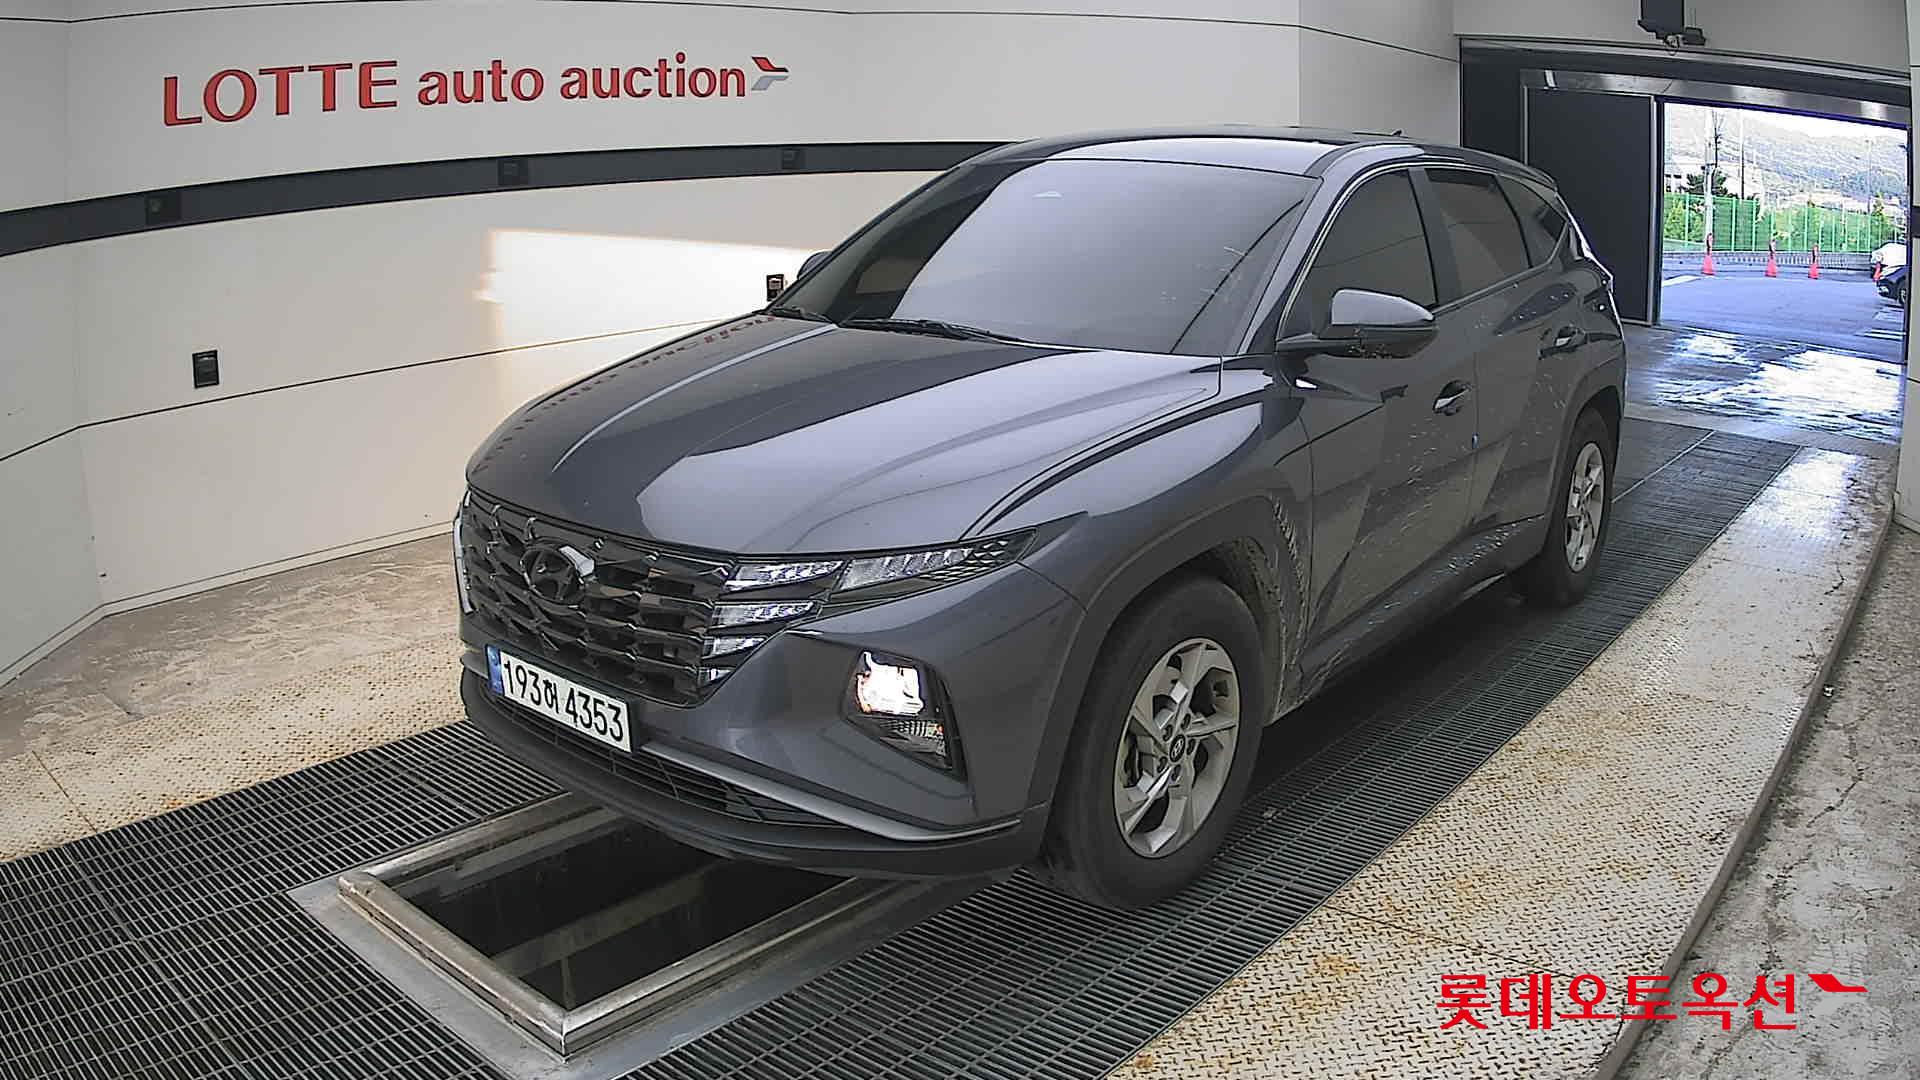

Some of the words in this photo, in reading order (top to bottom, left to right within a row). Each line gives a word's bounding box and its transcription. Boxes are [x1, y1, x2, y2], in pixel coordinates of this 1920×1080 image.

[163, 60, 397, 126] LOTTE
[417, 59, 544, 105] auto
[560, 52, 746, 99] auction
[565, 688, 623, 742] 4353
